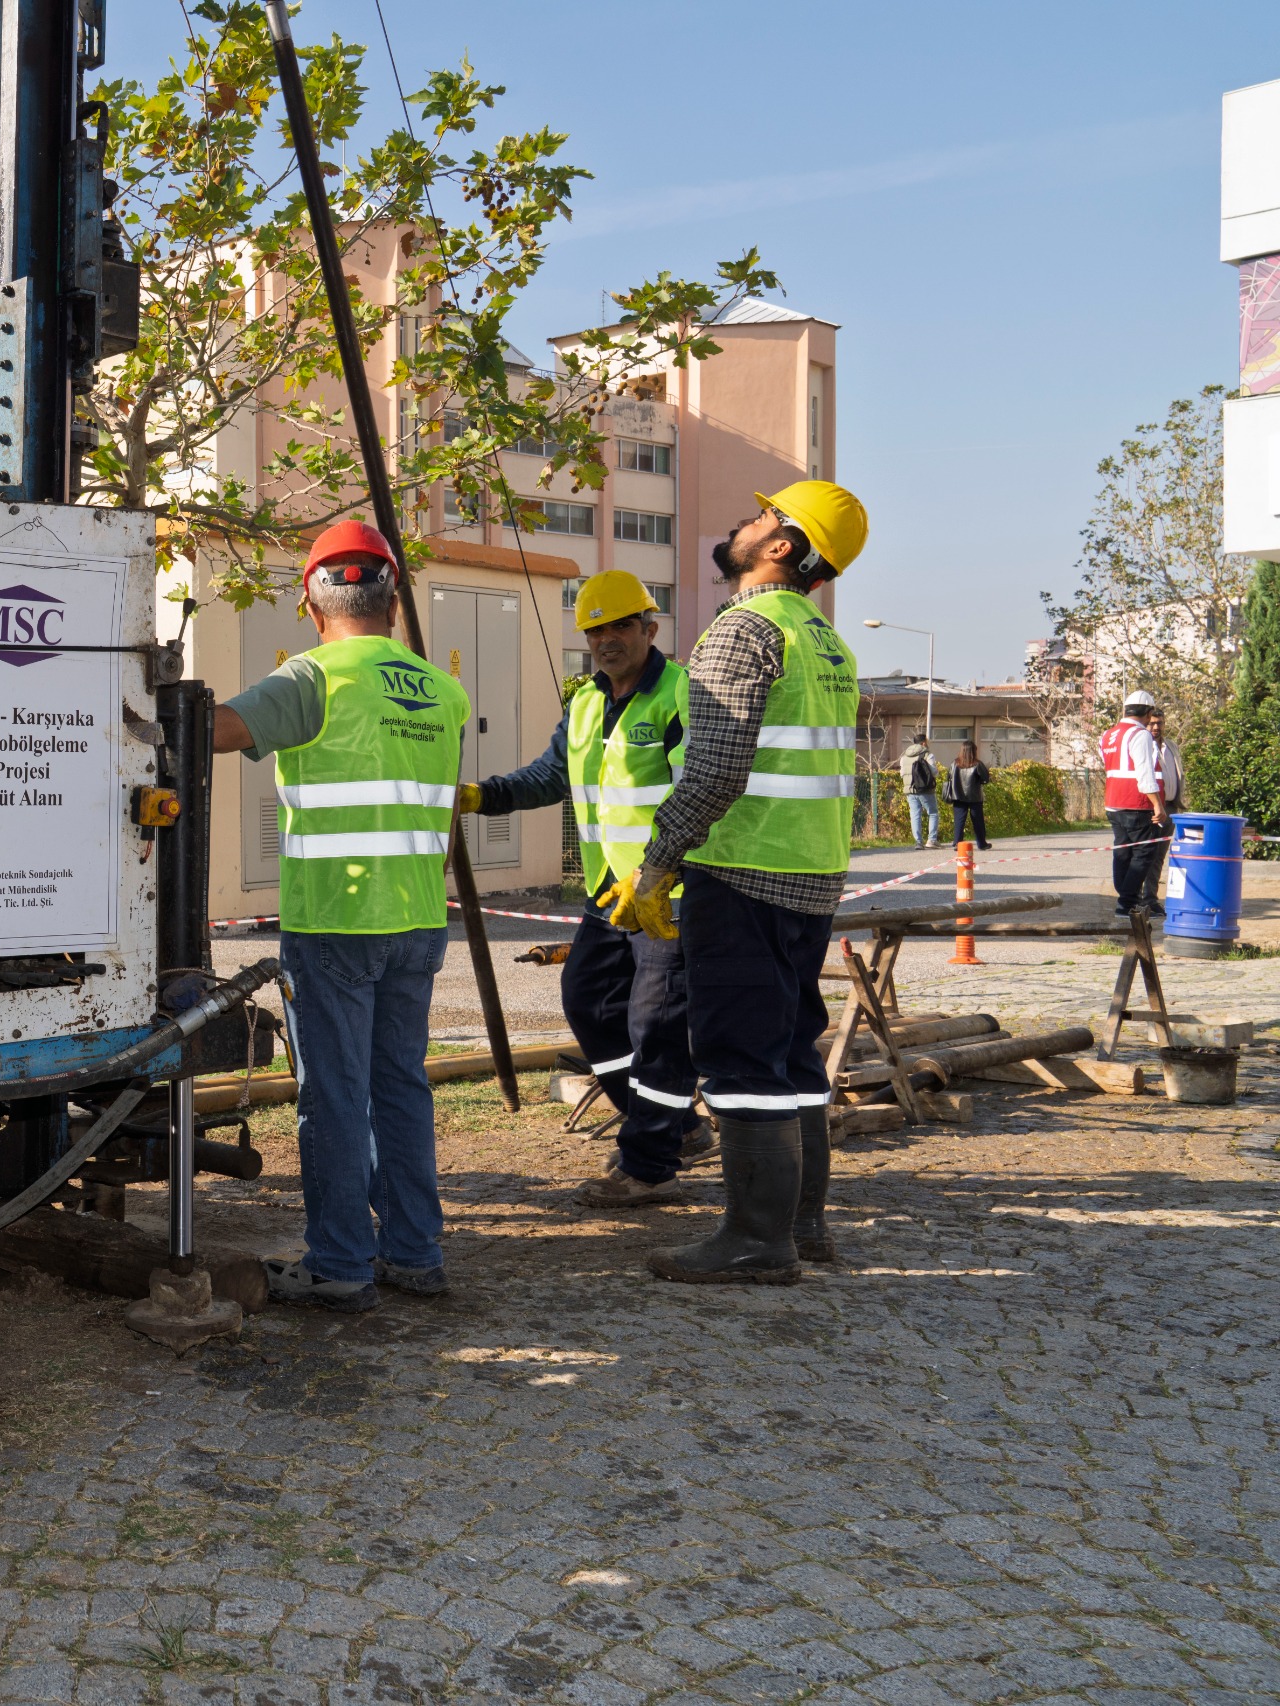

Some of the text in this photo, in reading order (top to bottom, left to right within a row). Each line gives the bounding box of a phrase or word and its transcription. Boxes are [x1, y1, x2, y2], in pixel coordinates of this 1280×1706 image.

[378, 669, 438, 699] MSC
[12, 707, 94, 730] Karşıyaka
[628, 728, 659, 740] MSC
[19, 789, 63, 806] Alanı
[28, 869, 73, 880] Sondajcılık
[8, 885, 58, 895] Mühendislik
[4, 898, 19, 908] Tic.
[21, 898, 38, 907] Ltd.
[40, 897, 54, 908] Şti.
